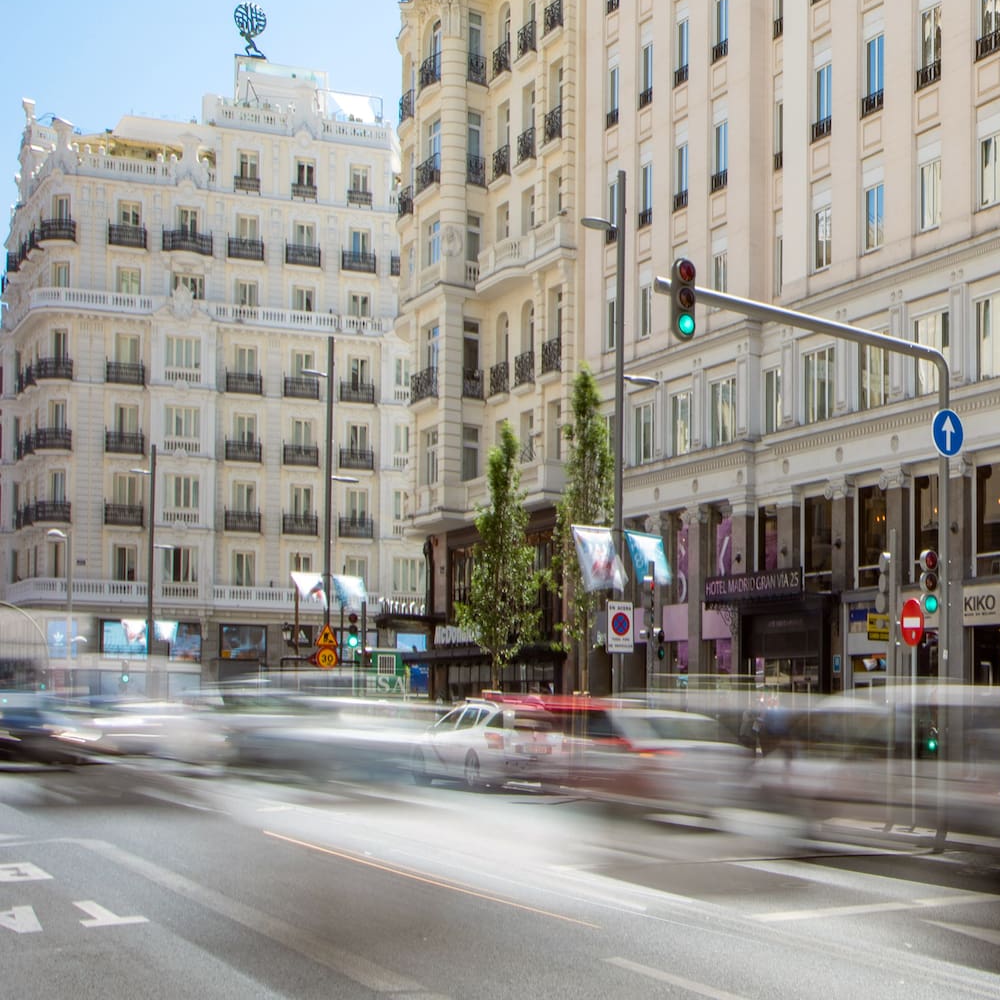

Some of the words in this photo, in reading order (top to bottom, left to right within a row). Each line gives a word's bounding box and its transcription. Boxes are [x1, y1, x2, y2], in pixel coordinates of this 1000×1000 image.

[705, 580, 727, 597] HOTEL
[728, 577, 755, 593] MADRID
[756, 574, 777, 591] GRAN
[790, 572, 799, 587] 25
[964, 594, 996, 612] KIKO
[321, 653, 334, 663] 30
